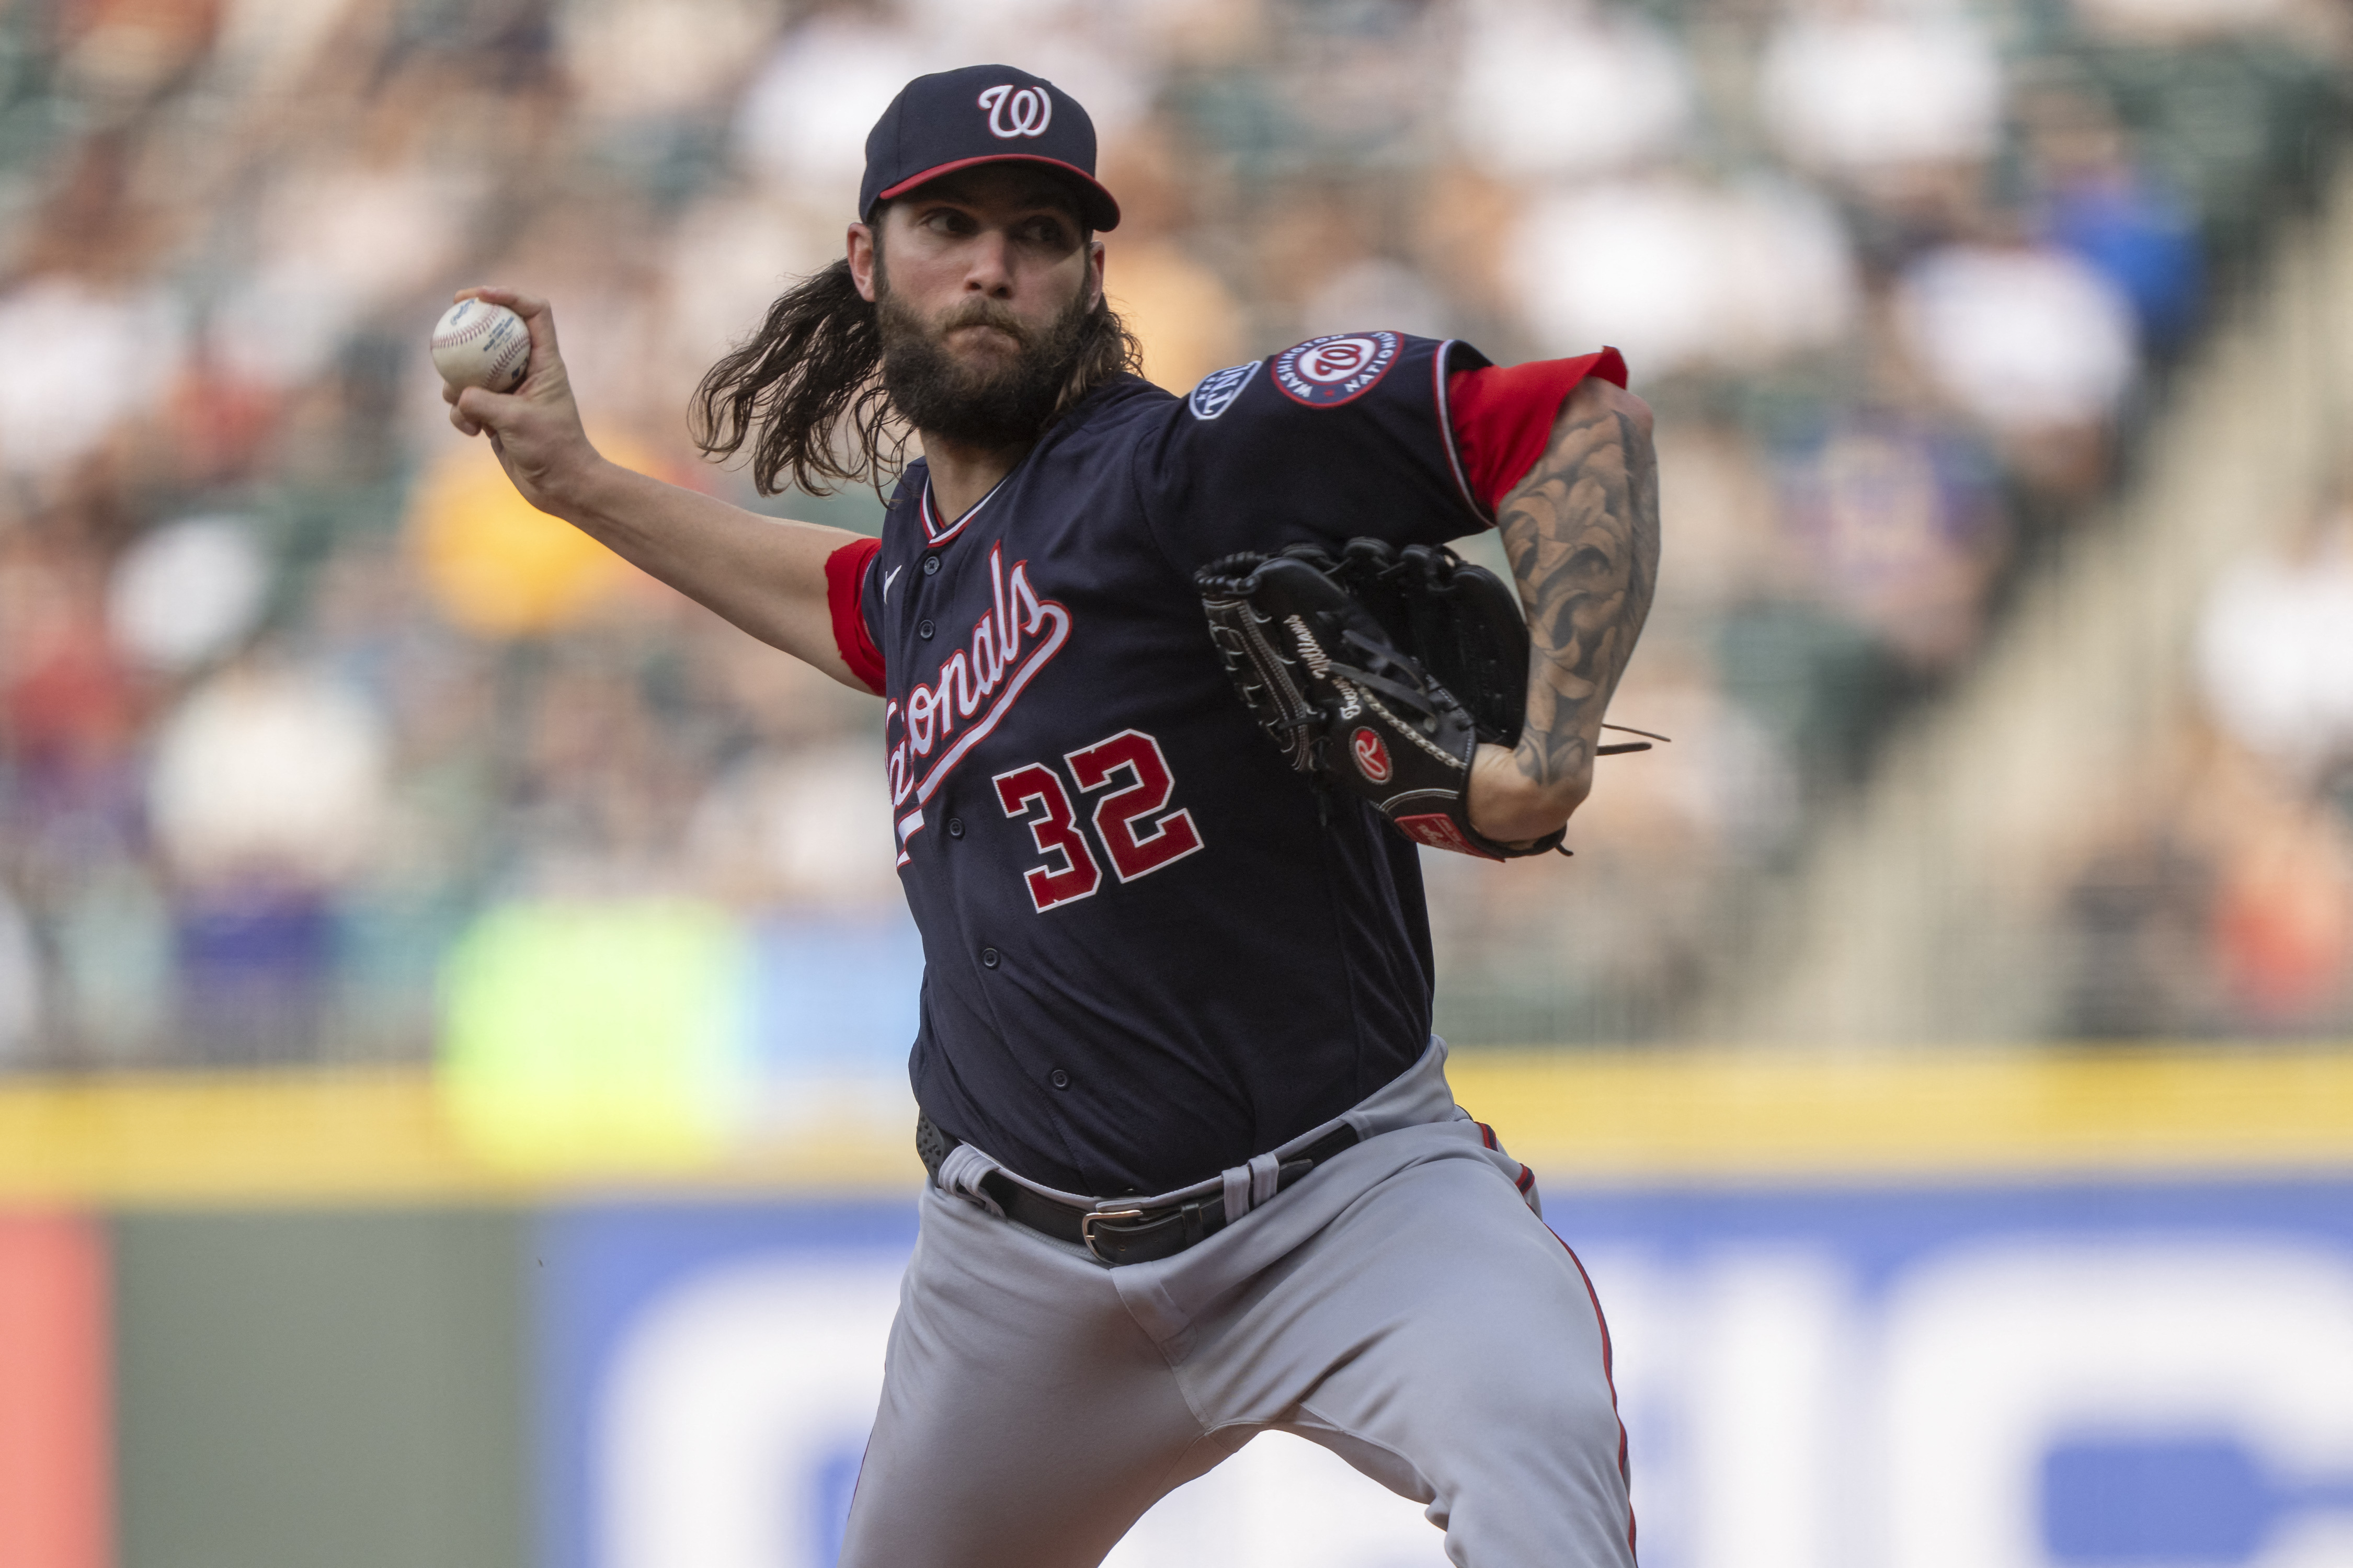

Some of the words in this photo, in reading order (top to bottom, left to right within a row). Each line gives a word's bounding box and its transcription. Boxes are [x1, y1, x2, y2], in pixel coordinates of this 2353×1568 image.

[977, 84, 1052, 140] W
[1277, 334, 1344, 397] WASHINGTON
[1315, 344, 1362, 376] W
[1344, 331, 1397, 393] NATIONALS
[886, 540, 1072, 810] aonals
[1355, 737, 1386, 779] R
[992, 728, 1205, 913] 32
